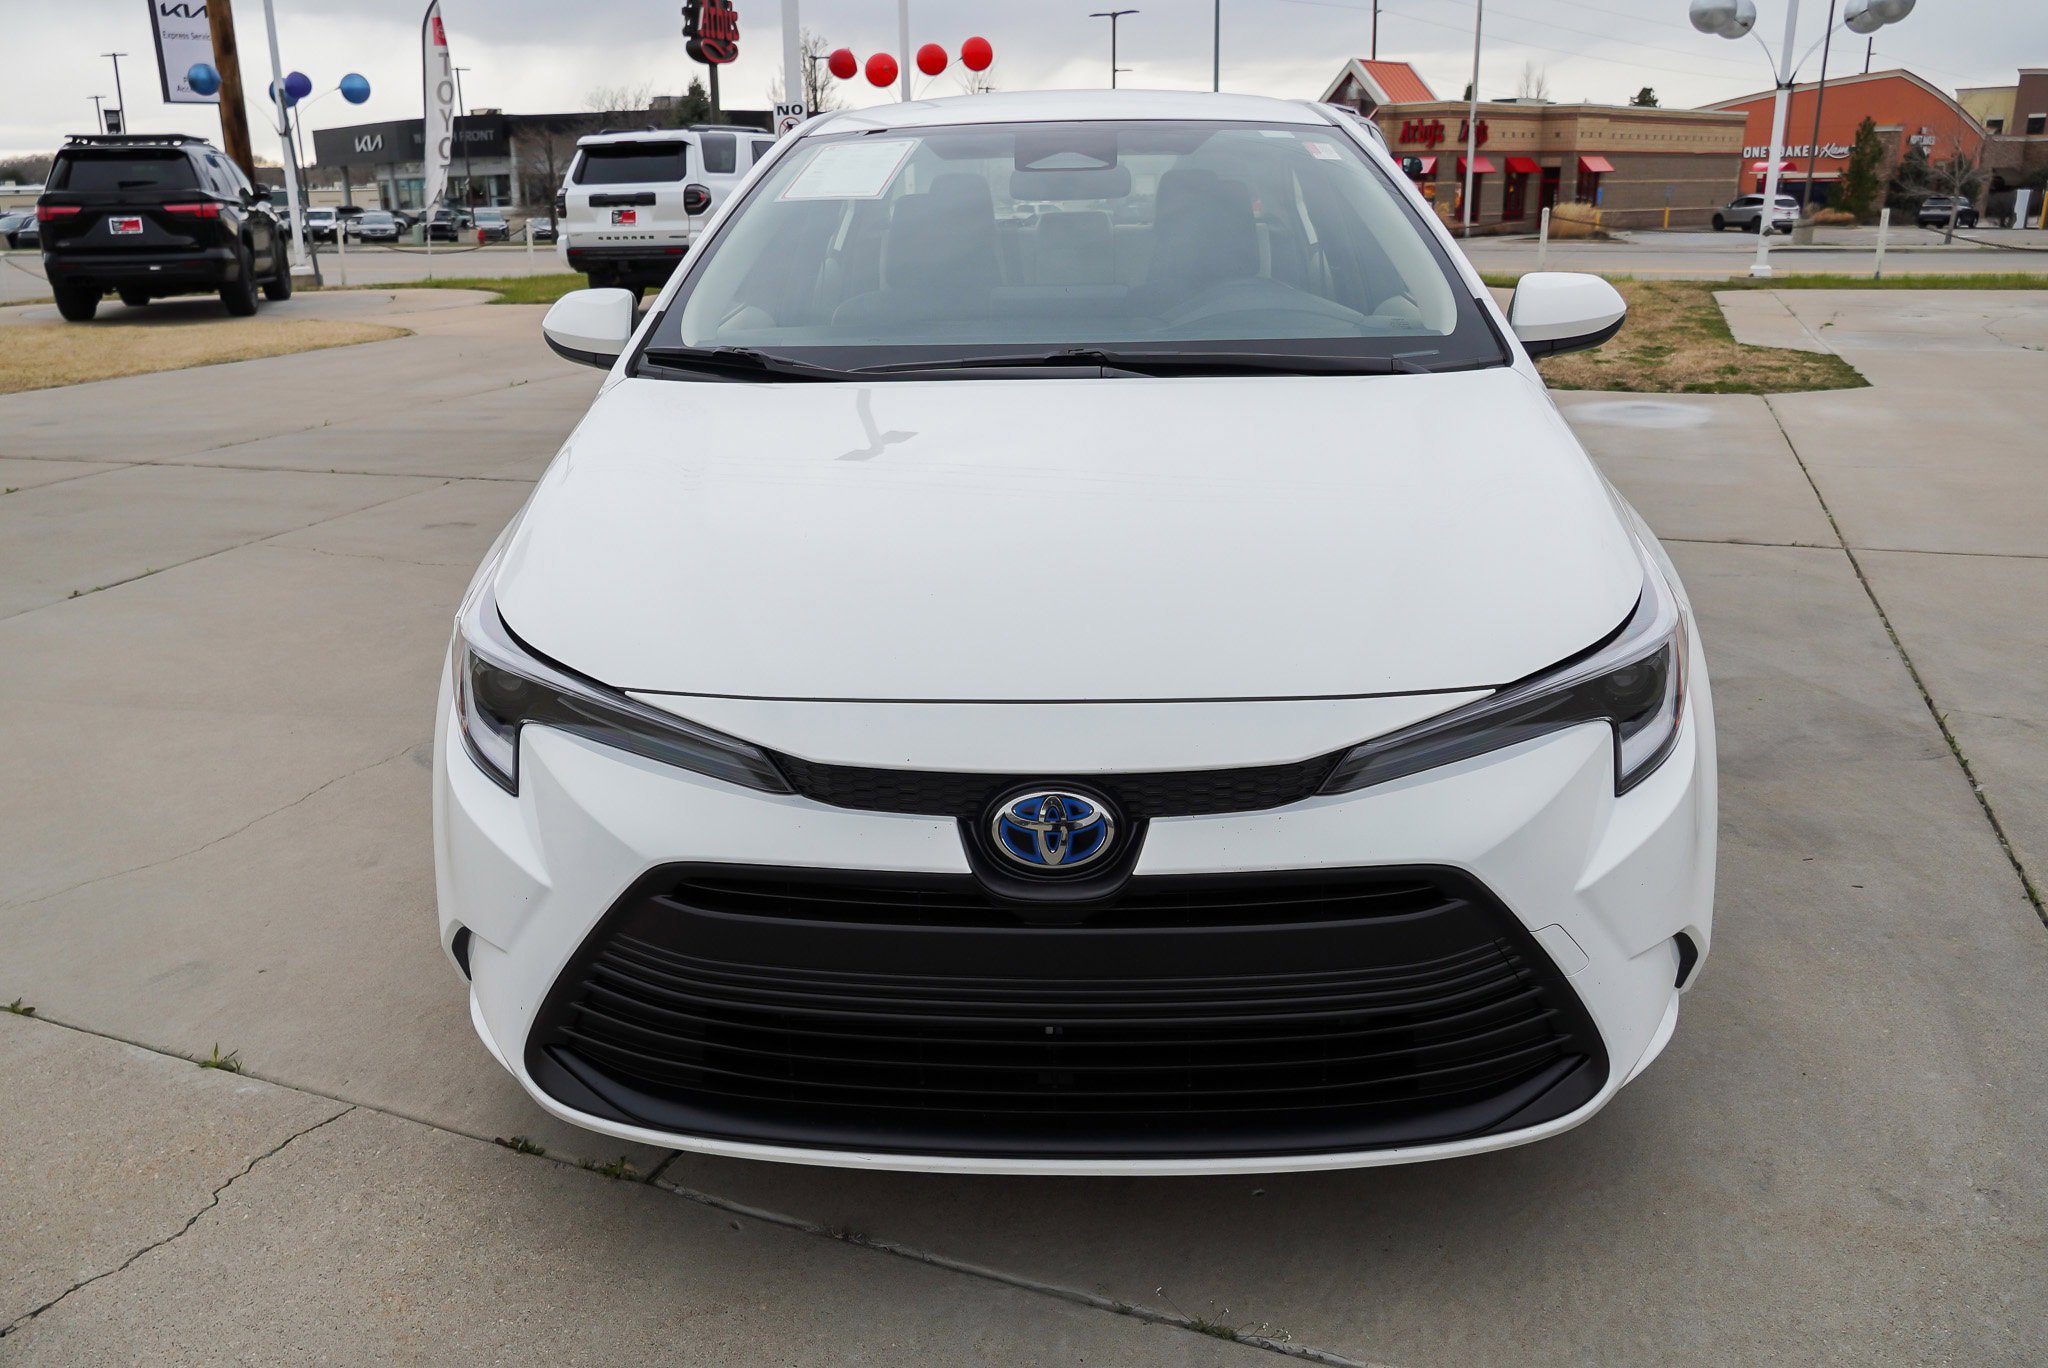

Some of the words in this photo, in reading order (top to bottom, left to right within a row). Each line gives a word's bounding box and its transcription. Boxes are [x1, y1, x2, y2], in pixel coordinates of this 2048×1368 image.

[160, 3, 208, 18] KIA
[162, 30, 189, 40] Express
[776, 104, 804, 116] NO
[1398, 117, 1446, 149] Arby's
[354, 135, 383, 152] KIA
